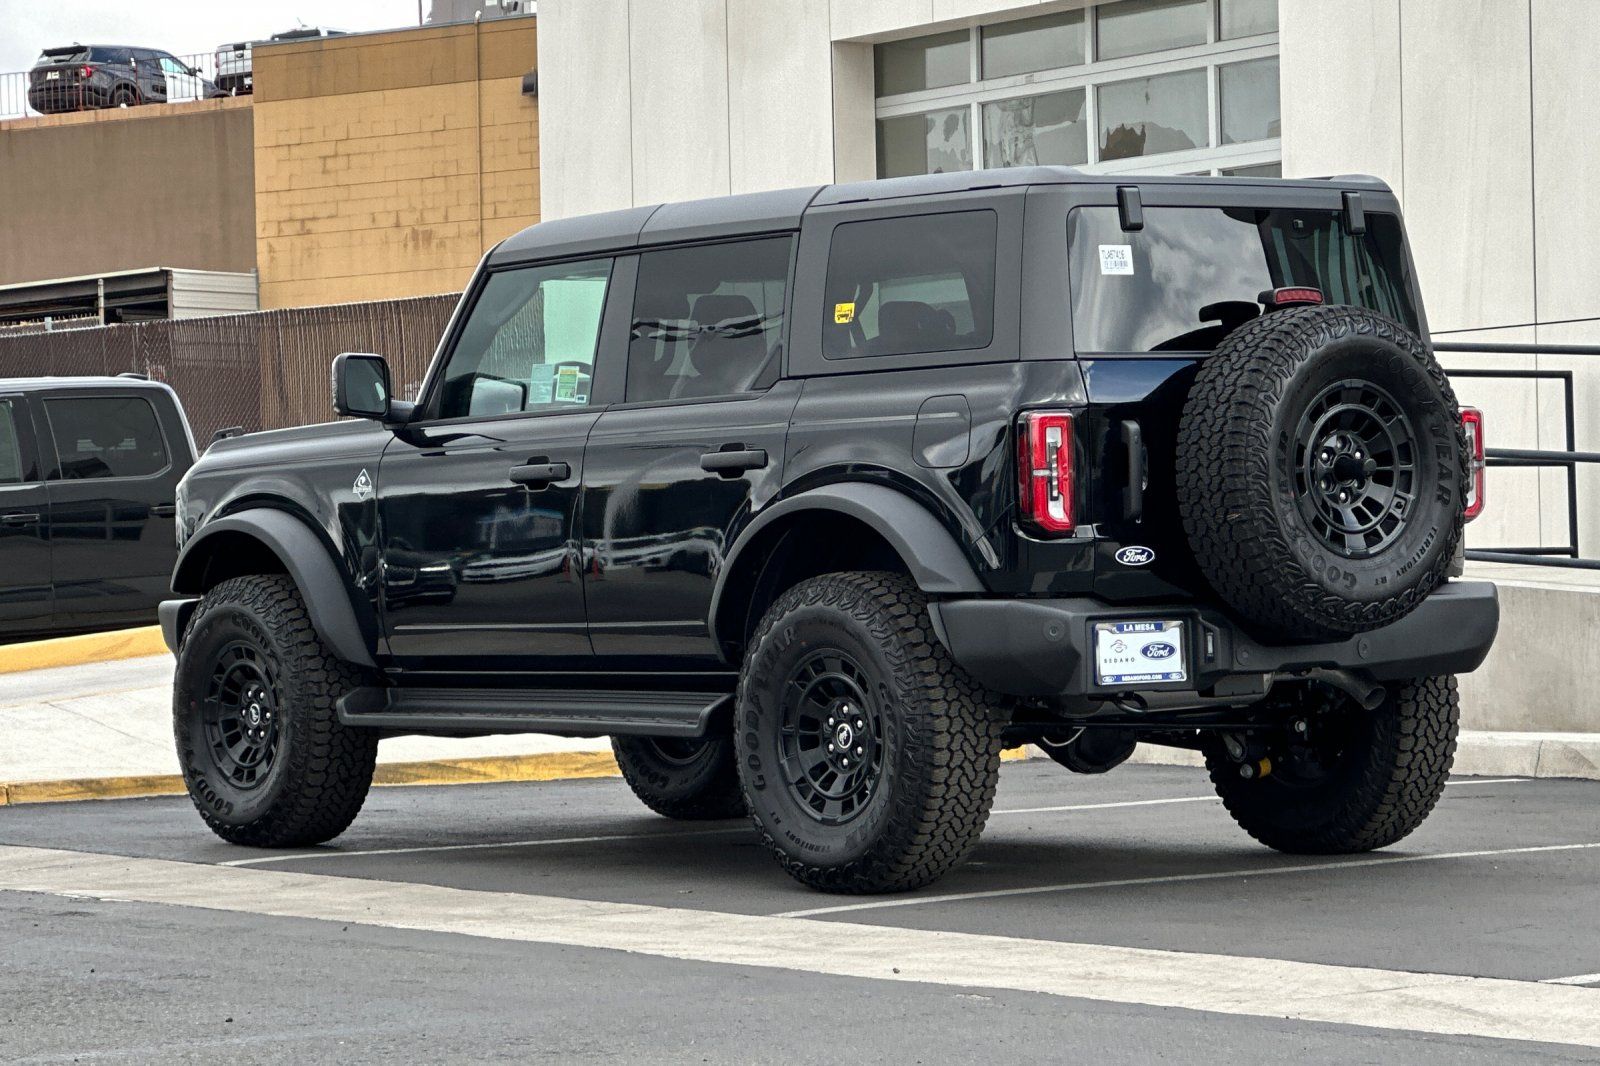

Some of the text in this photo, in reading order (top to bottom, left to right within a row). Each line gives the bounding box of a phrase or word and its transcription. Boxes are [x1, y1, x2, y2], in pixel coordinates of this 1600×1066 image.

[1396, 526, 1438, 578] TERRITORY
[1123, 623, 1155, 632] LA MESA
